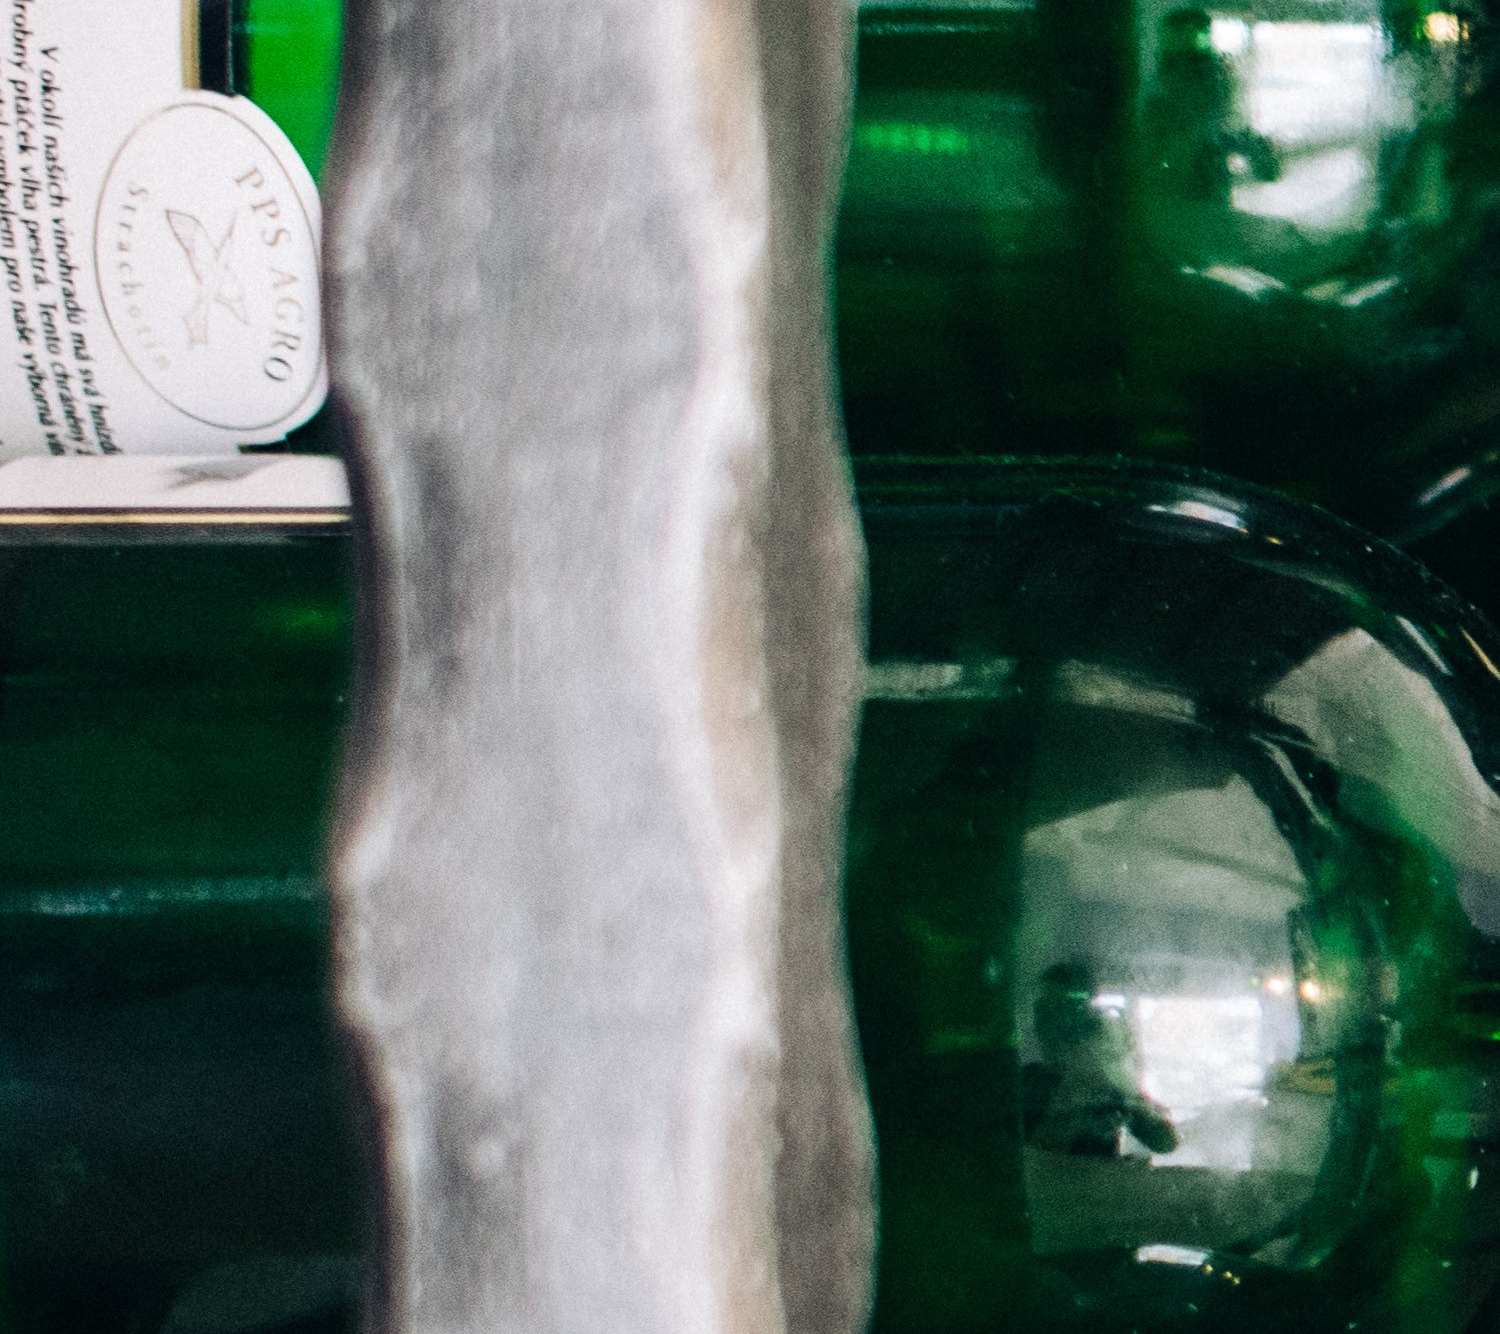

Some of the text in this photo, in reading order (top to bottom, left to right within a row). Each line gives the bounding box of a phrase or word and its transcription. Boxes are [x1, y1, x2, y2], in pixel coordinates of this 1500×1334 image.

[40, 46, 59, 64] V
[7, 78, 39, 155] ptáček
[41, 69, 64, 131] okolí
[20, 166, 42, 211] vlha
[44, 135, 71, 208] našich
[0, 256, 22, 293] pro
[12, 300, 36, 346] naše
[52, 217, 87, 325] vinohradů
[233, 166, 305, 383] PPS AGRO
[38, 302, 61, 355] Tento
[71, 331, 95, 362] má
[78, 368, 103, 398] svá
